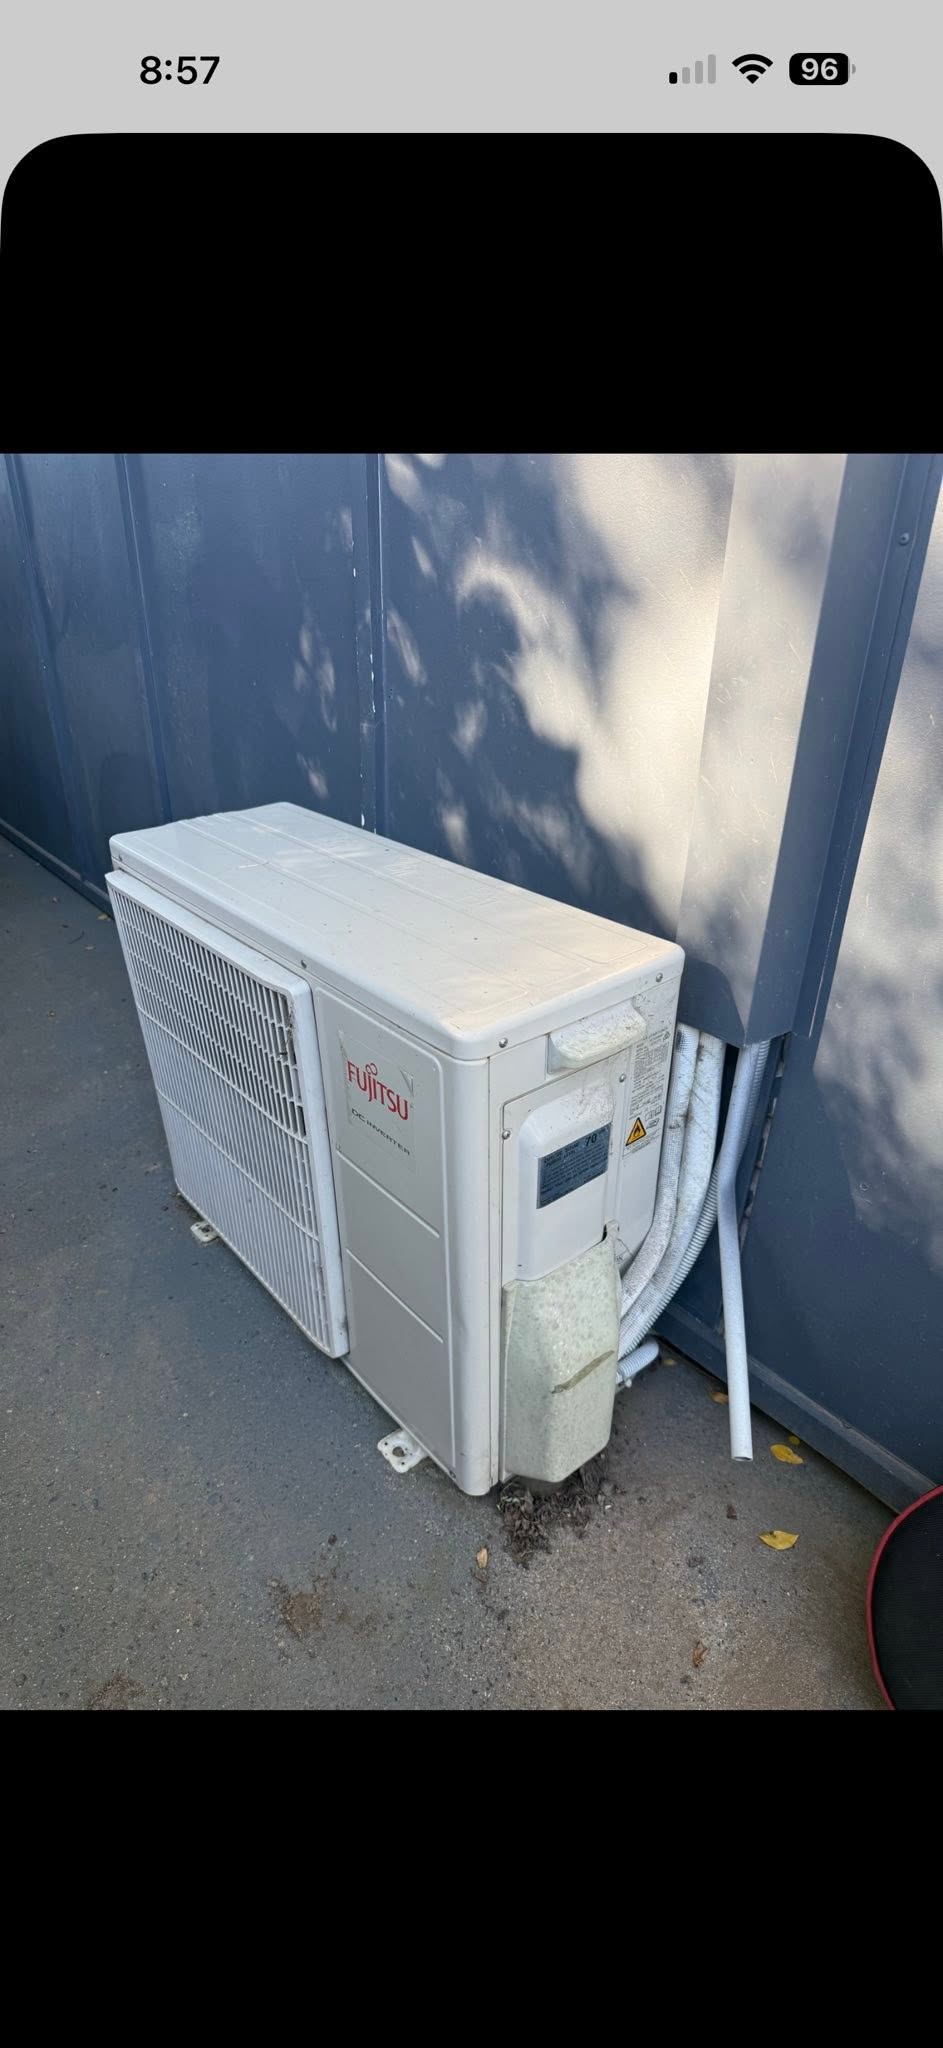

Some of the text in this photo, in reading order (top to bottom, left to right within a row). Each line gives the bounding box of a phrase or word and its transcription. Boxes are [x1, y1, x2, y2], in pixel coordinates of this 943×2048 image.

[347, 1060, 408, 1120] FUJITSU
[351, 1108, 410, 1156] DC INVERTER
[585, 1133, 598, 1147] 70
